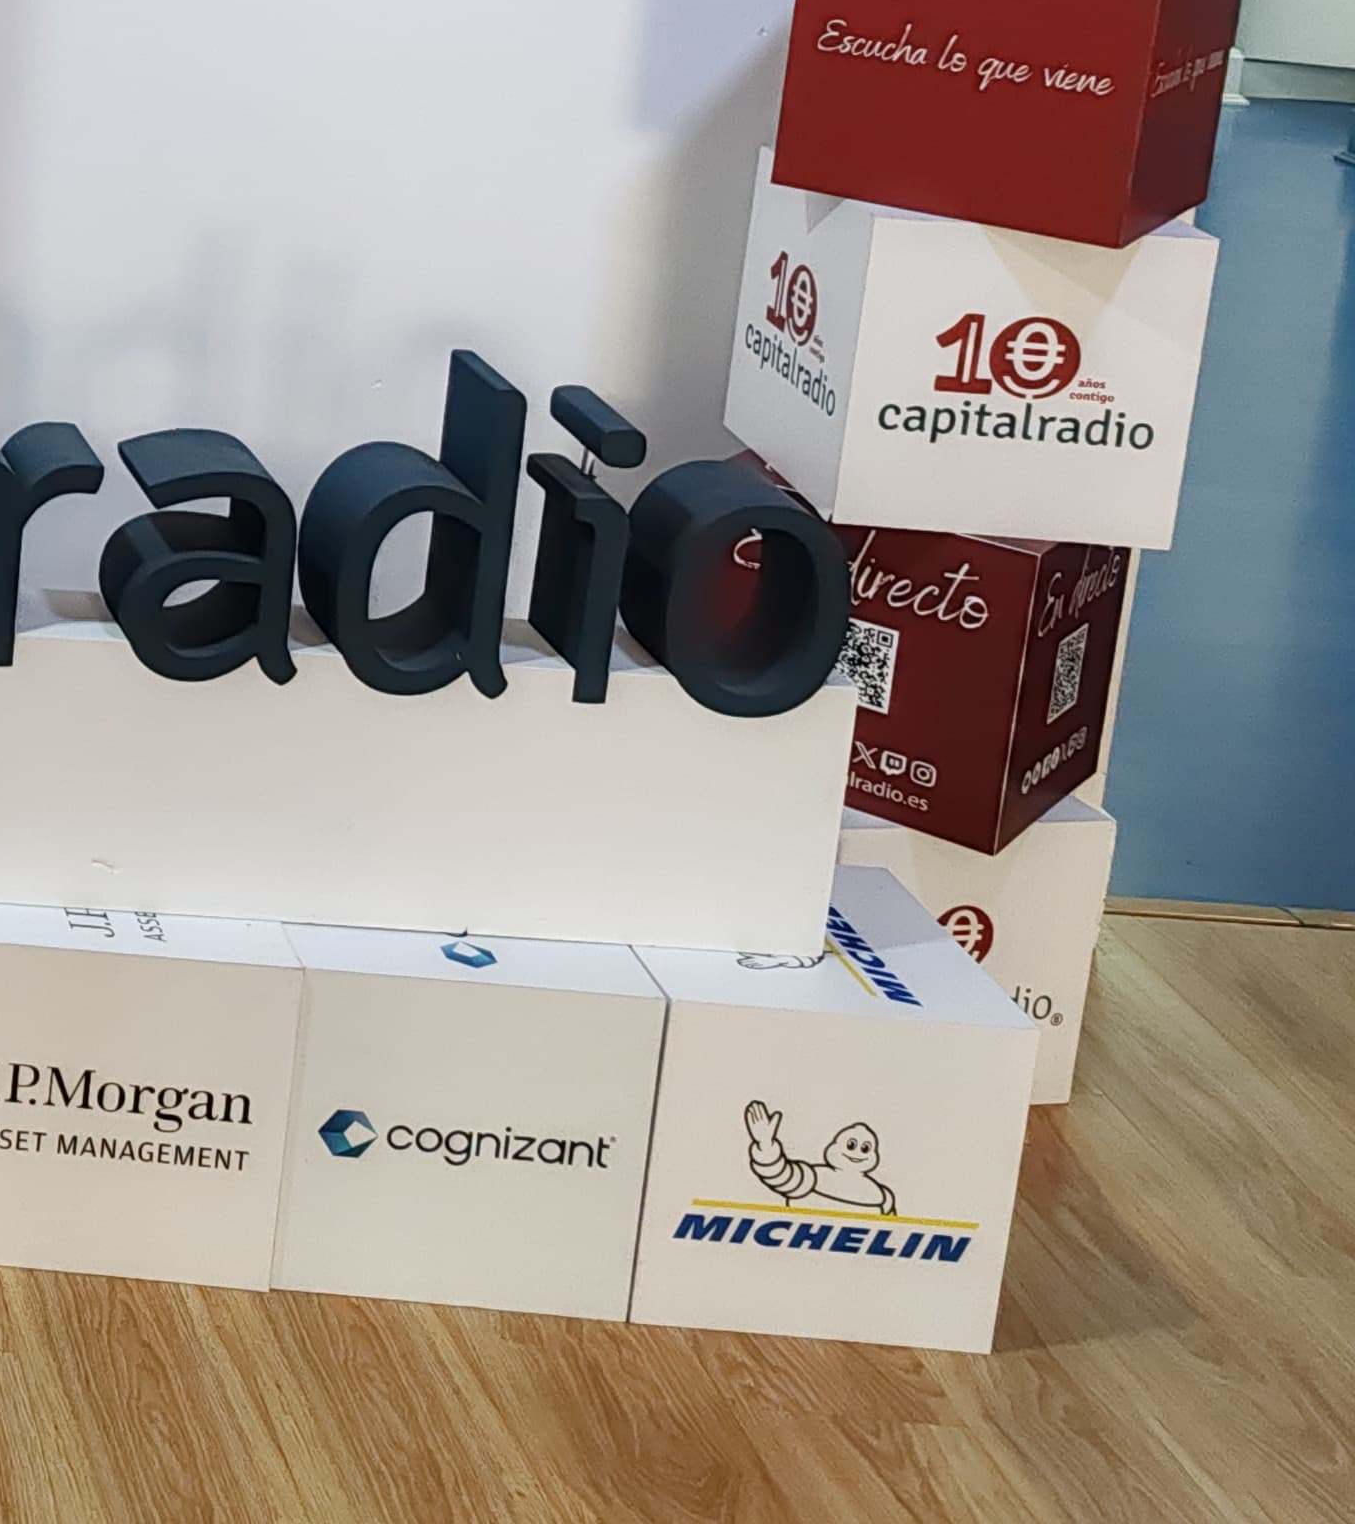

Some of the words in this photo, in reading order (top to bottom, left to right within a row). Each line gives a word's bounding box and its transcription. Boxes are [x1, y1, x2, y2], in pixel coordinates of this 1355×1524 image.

[817, 19, 927, 67] Escucha
[938, 34, 967, 72] lo
[977, 55, 1033, 93] que
[1043, 65, 1115, 97] viene
[744, 321, 836, 417] capitalradio
[1077, 378, 1106, 390] años
[1069, 390, 1115, 404] contigo
[878, 402, 1155, 451] capitalradio
[849, 771, 929, 811] lradio.es
[55, 1134, 251, 1172] MANAGEMENT
[387, 1123, 611, 1169] cognizant
[672, 1213, 972, 1264] MICHELIN
